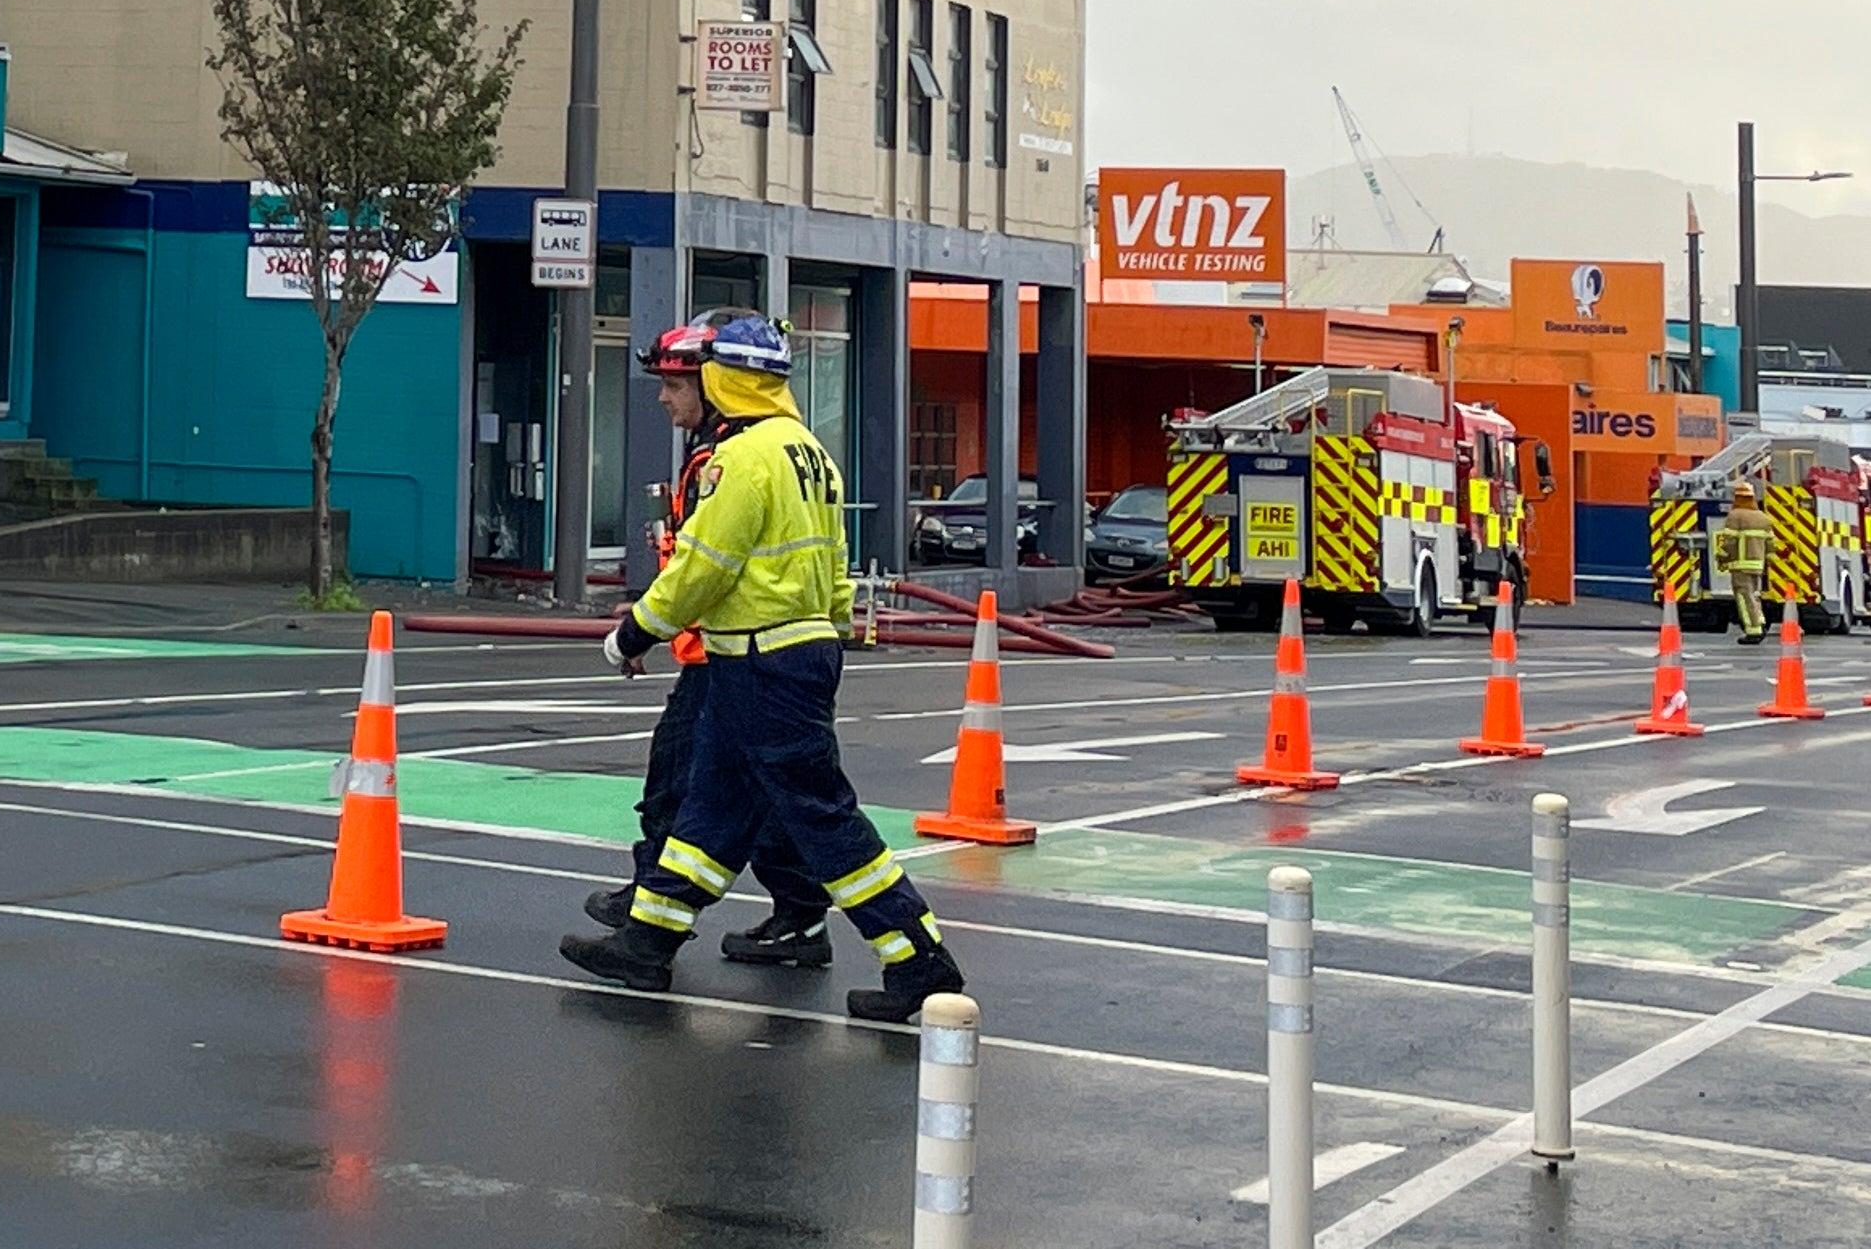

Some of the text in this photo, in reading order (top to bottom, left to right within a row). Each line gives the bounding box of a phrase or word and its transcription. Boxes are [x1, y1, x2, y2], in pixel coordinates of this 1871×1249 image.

[709, 41, 772, 56] ROOMS
[707, 56, 772, 72] TO LET
[1111, 180, 1272, 248] vtnz
[541, 236, 581, 252] LANE
[1118, 252, 1267, 272] VEHICLE TESTING
[539, 266, 585, 280] BEGINS
[1250, 506, 1296, 524] FIRE
[1256, 540, 1291, 557] AHI
